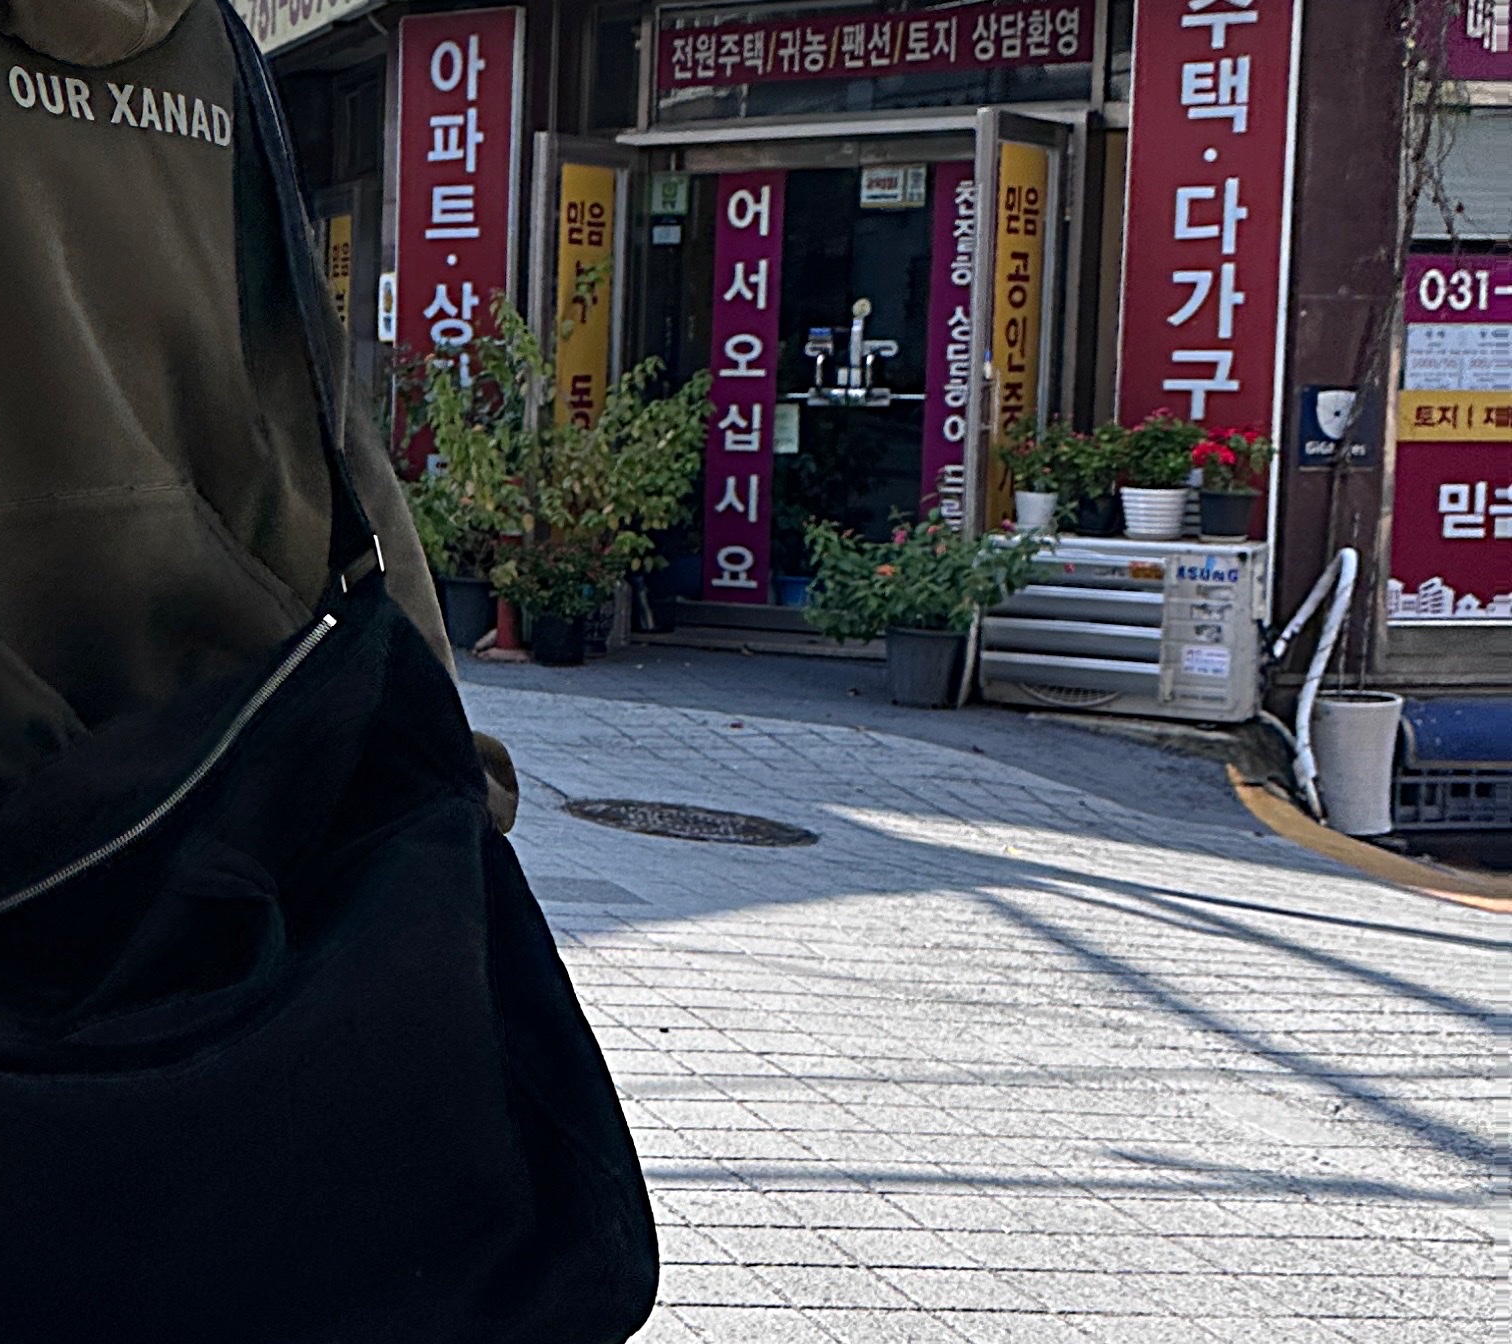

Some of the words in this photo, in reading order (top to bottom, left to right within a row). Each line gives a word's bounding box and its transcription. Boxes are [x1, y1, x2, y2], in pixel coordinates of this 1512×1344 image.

[972, 7, 1080, 61] 상담환영
[9, 66, 94, 121] OUR
[566, 201, 606, 246] 믿음
[1005, 186, 1039, 236] 믿음
[1413, 404, 1458, 430] 토지
